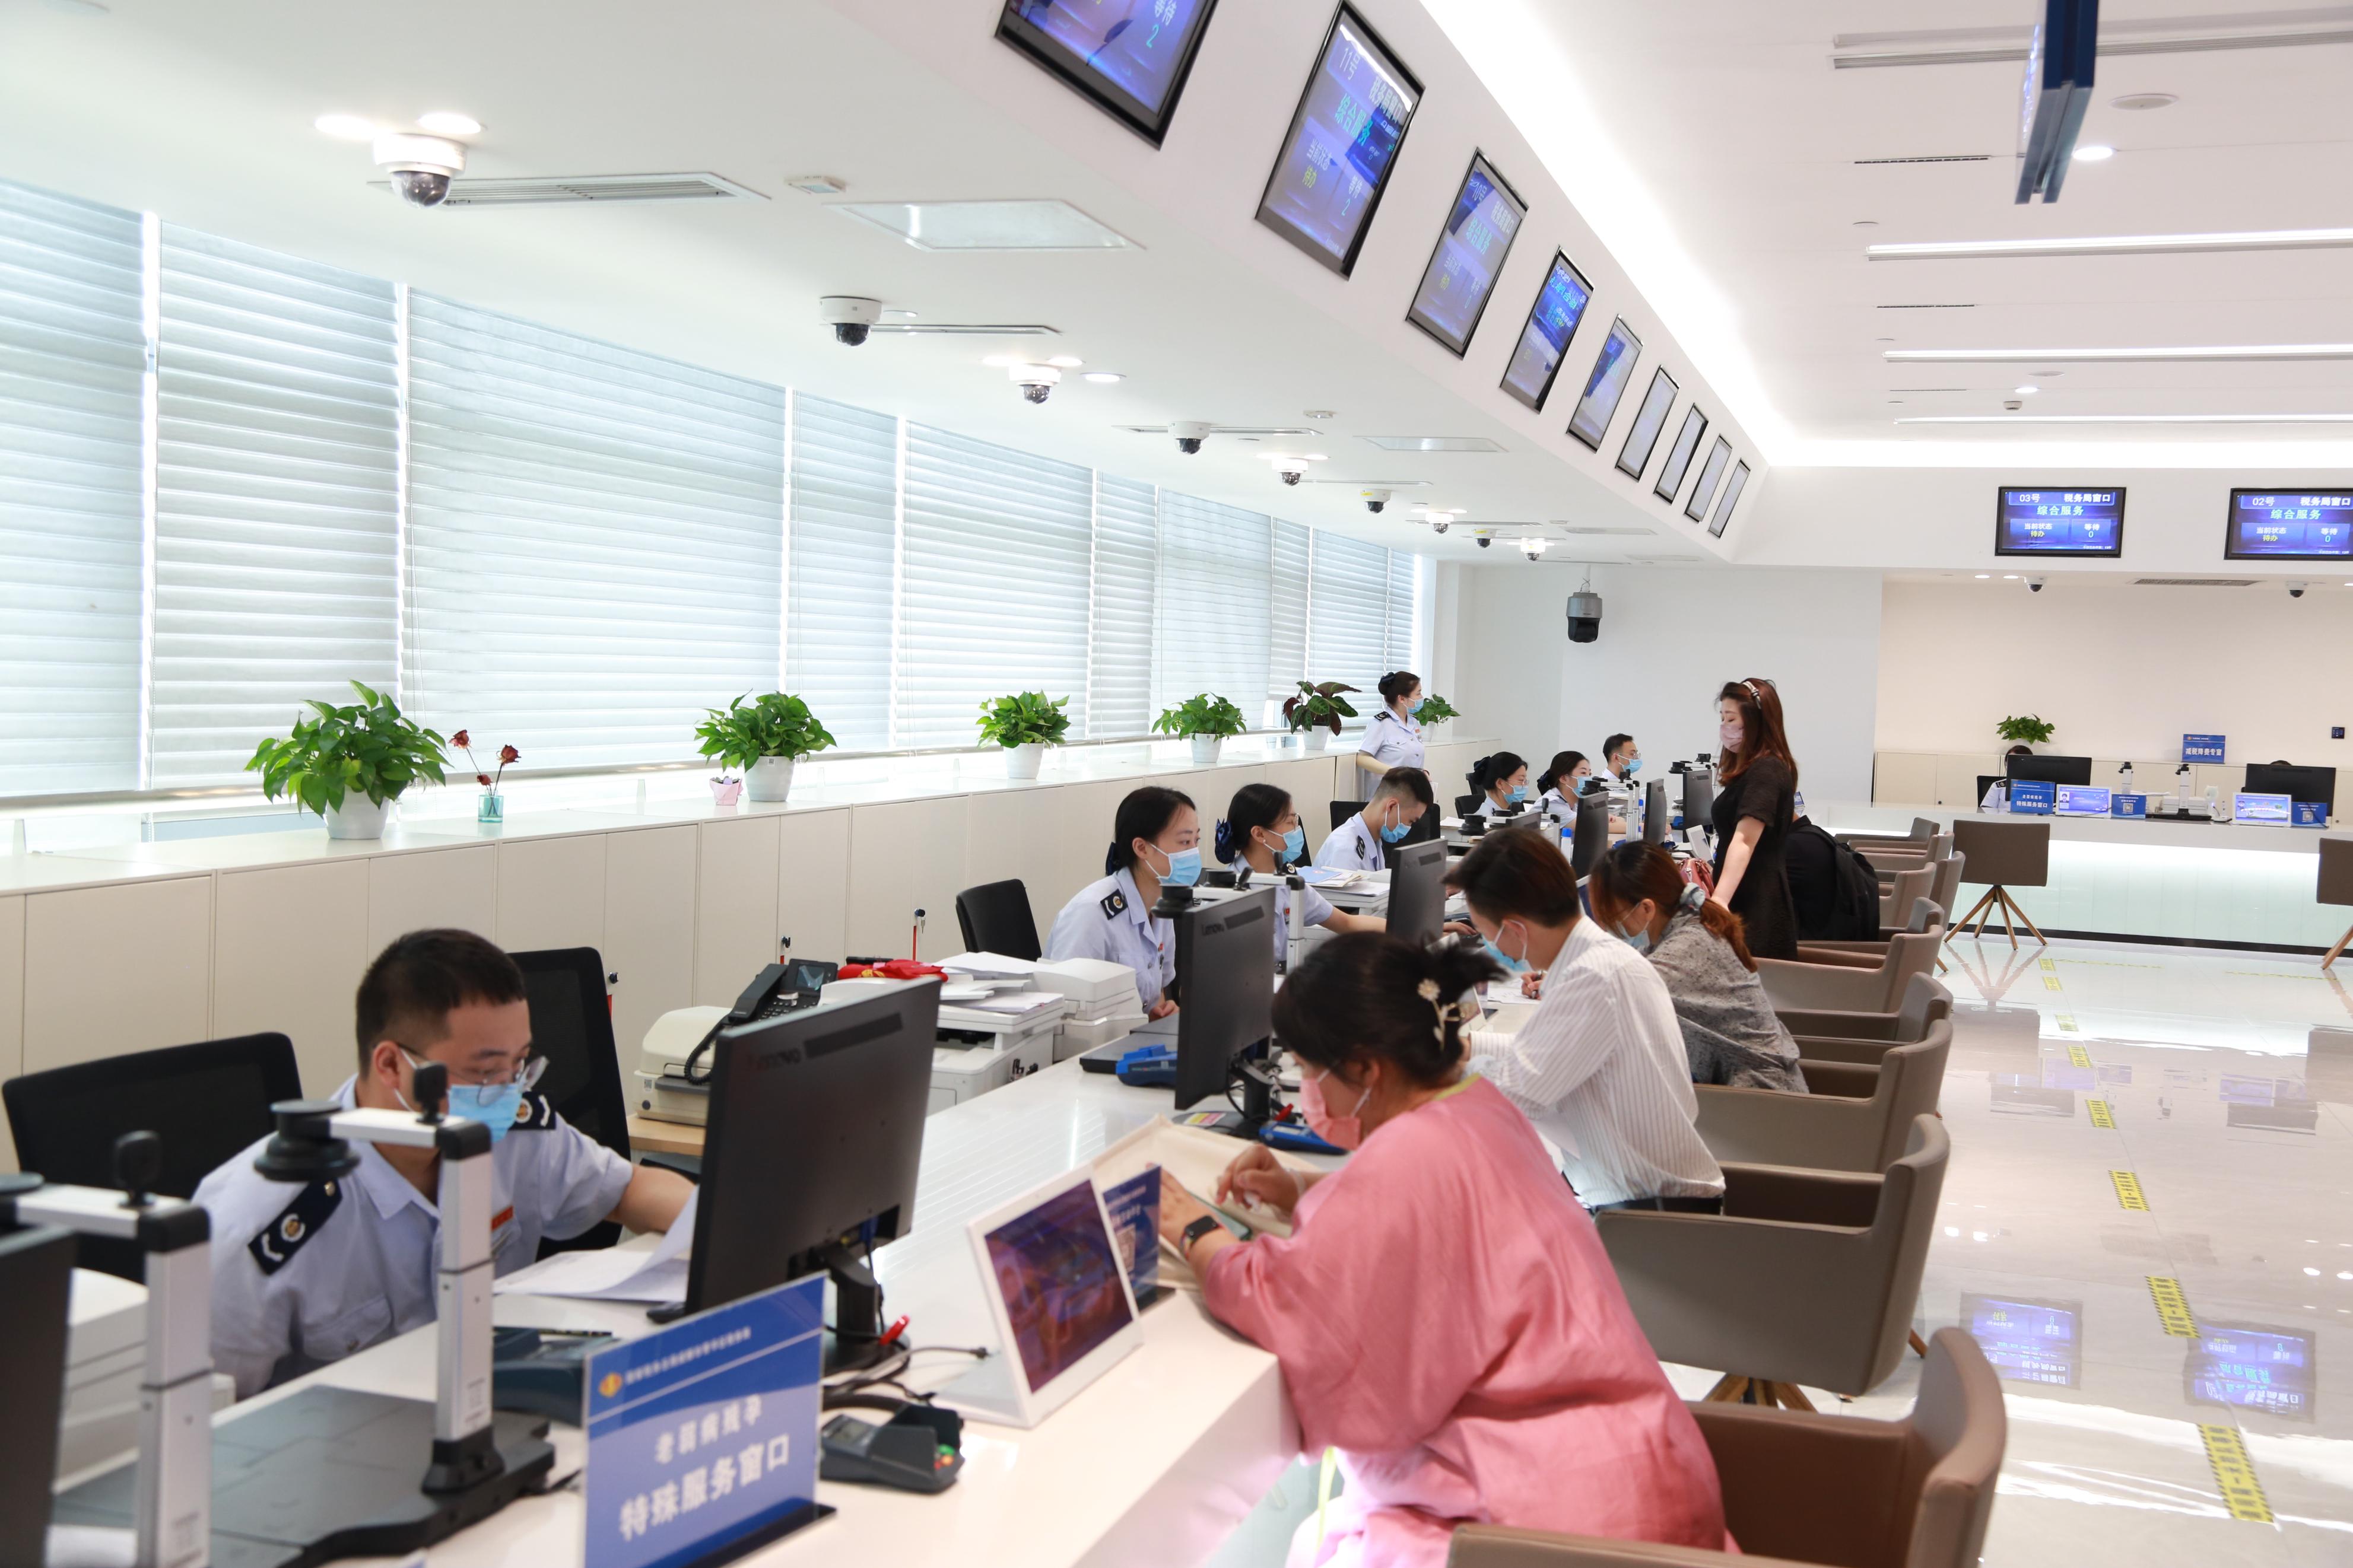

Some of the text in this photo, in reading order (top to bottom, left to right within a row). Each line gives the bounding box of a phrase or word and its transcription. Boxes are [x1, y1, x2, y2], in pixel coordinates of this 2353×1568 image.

[1146, 24, 1159, 48] 2
[1339, 47, 1403, 124] 11号 税务局窗口
[1335, 93, 1373, 146] 综合服务
[1306, 138, 1332, 171] 当前状态
[1348, 175, 1363, 199] 等待
[1341, 199, 1351, 217] 2
[2019, 494, 2110, 503] 03号 税务局窗口
[2252, 497, 2351, 506] 02号 税务局窗口
[2037, 505, 2084, 516] 综合服务
[2271, 509, 2321, 520] 综合服务
[2185, 748, 2222, 756] 减税降费专窗
[620, 1434, 790, 1542] 特殊服务窗口
